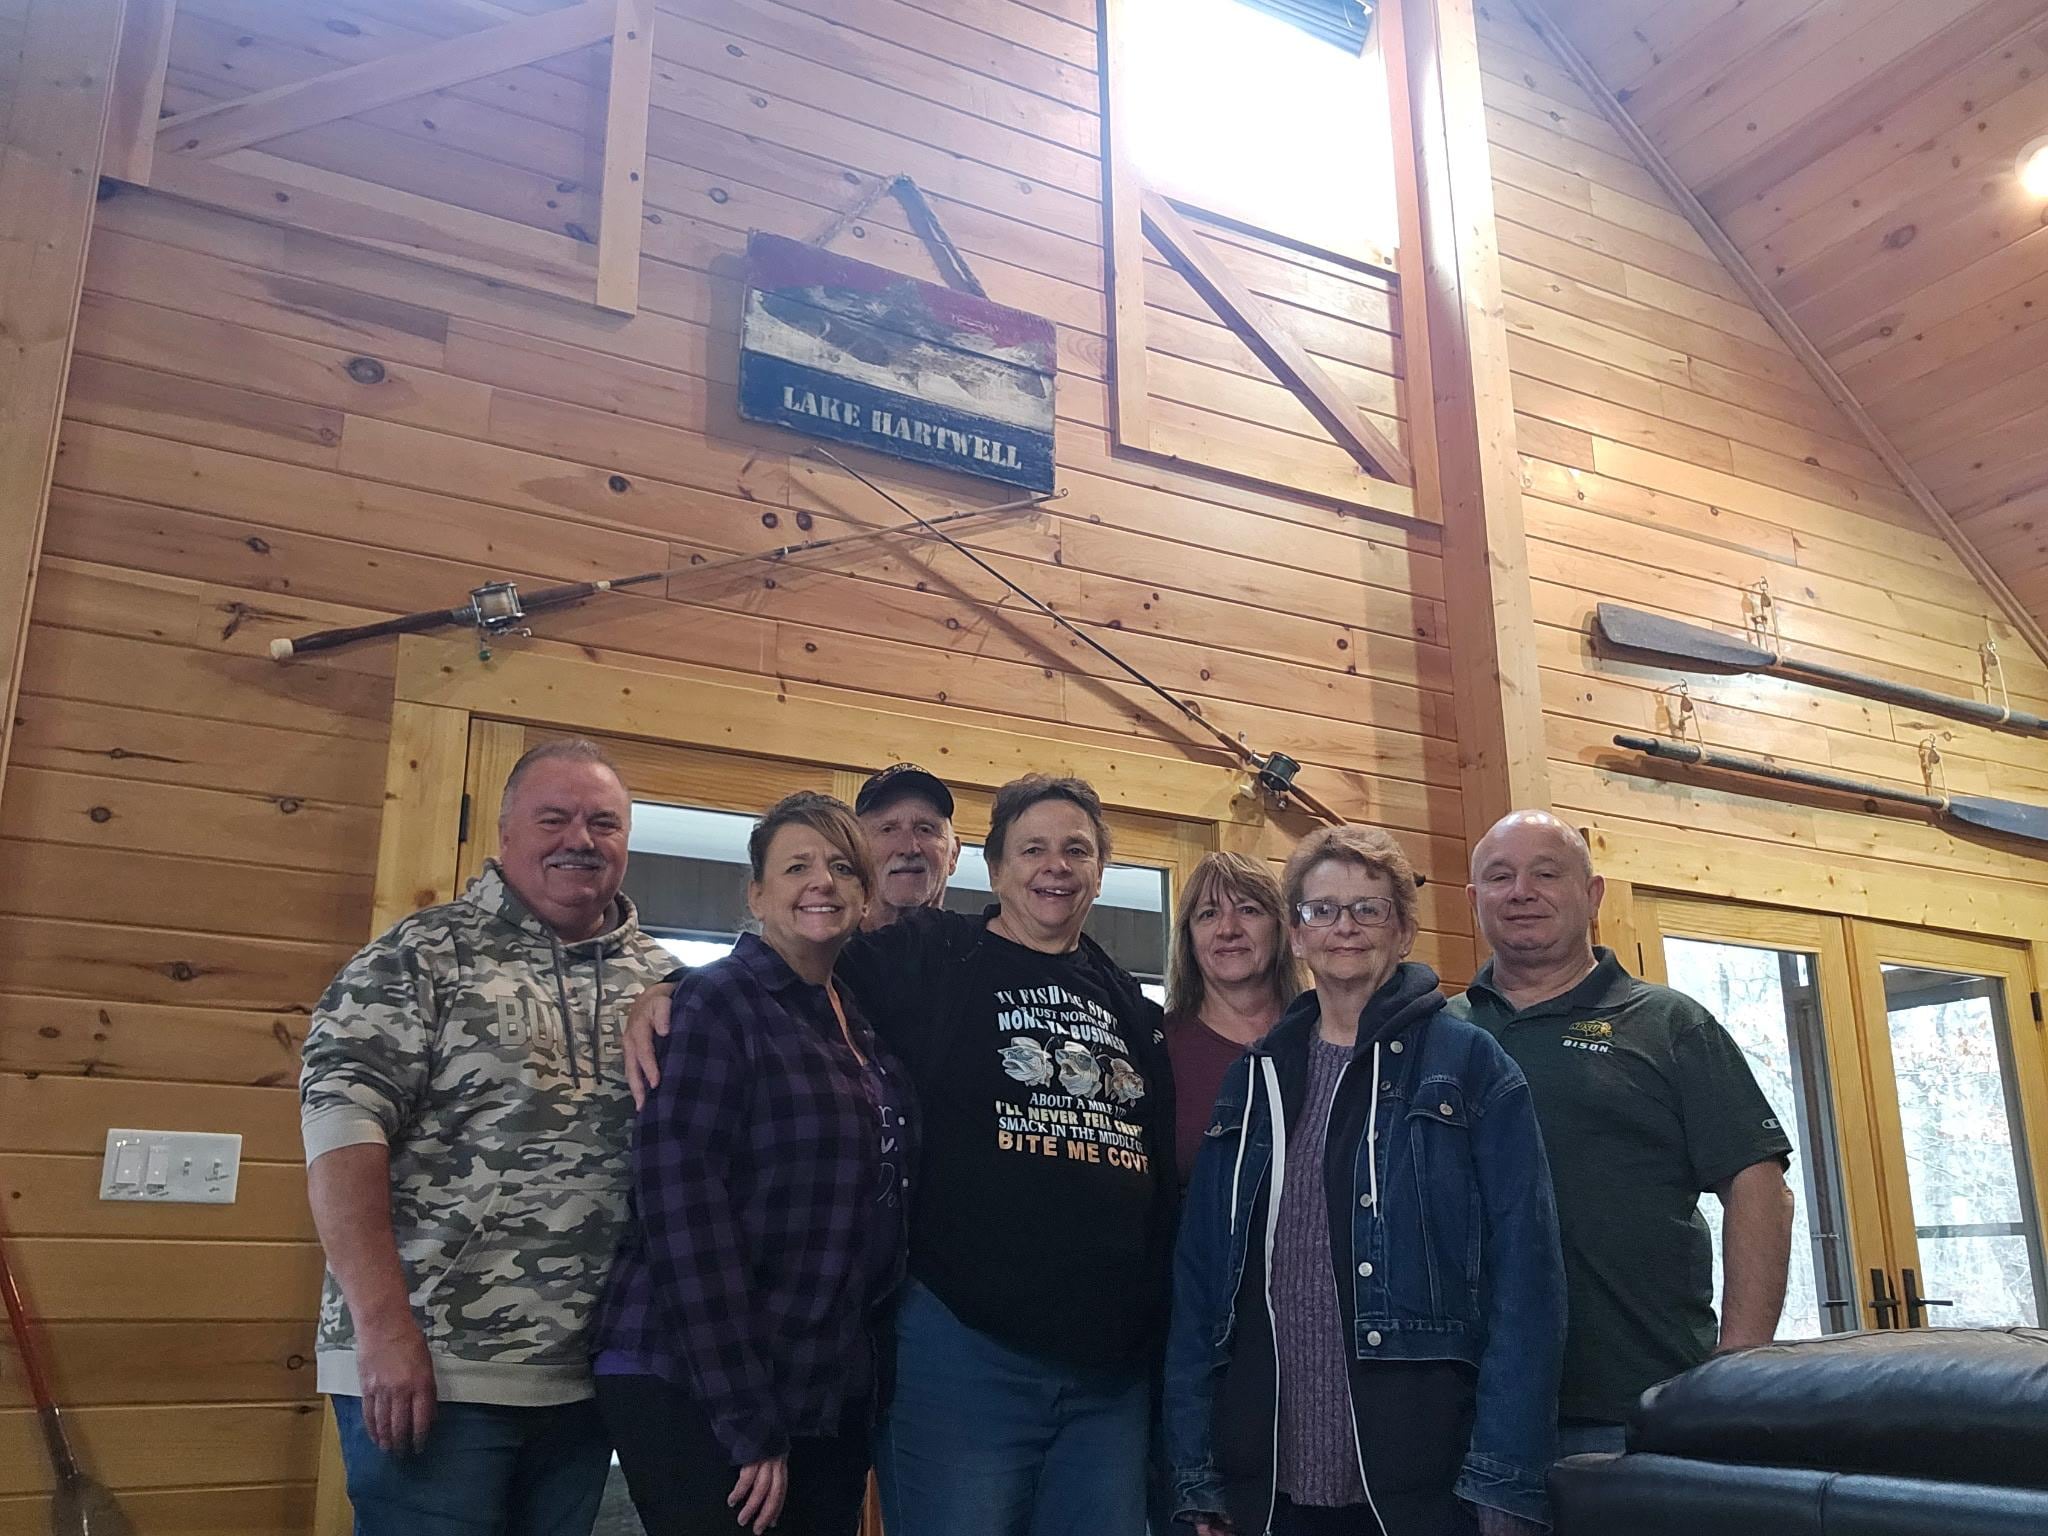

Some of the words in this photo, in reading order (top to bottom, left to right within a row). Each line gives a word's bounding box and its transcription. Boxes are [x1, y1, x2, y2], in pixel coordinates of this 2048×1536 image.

[783, 385, 861, 427] LAKE
[870, 409, 1022, 470] HARTWELL
[1030, 1007, 1057, 1019] JUST
[1087, 999, 1118, 1031] SPOT
[1562, 1039, 1609, 1053] BISON
[995, 1100, 1024, 1116] I'LL
[1028, 1106, 1079, 1125] NEVER
[1082, 1112, 1112, 1131] TELL
[1029, 1092, 1073, 1109] ABOUT
[1076, 1099, 1086, 1110] A
[1088, 1100, 1114, 1116] MILE
[999, 1116, 1049, 1133] SMACK
[1050, 1123, 1066, 1138] IN
[1069, 1126, 1096, 1141] THE
[1098, 1130, 1136, 1150] MIDDLE
[998, 1129, 1058, 1157] BITE
[1067, 1140, 1101, 1164] ME
[1107, 1146, 1150, 1175] COVE
